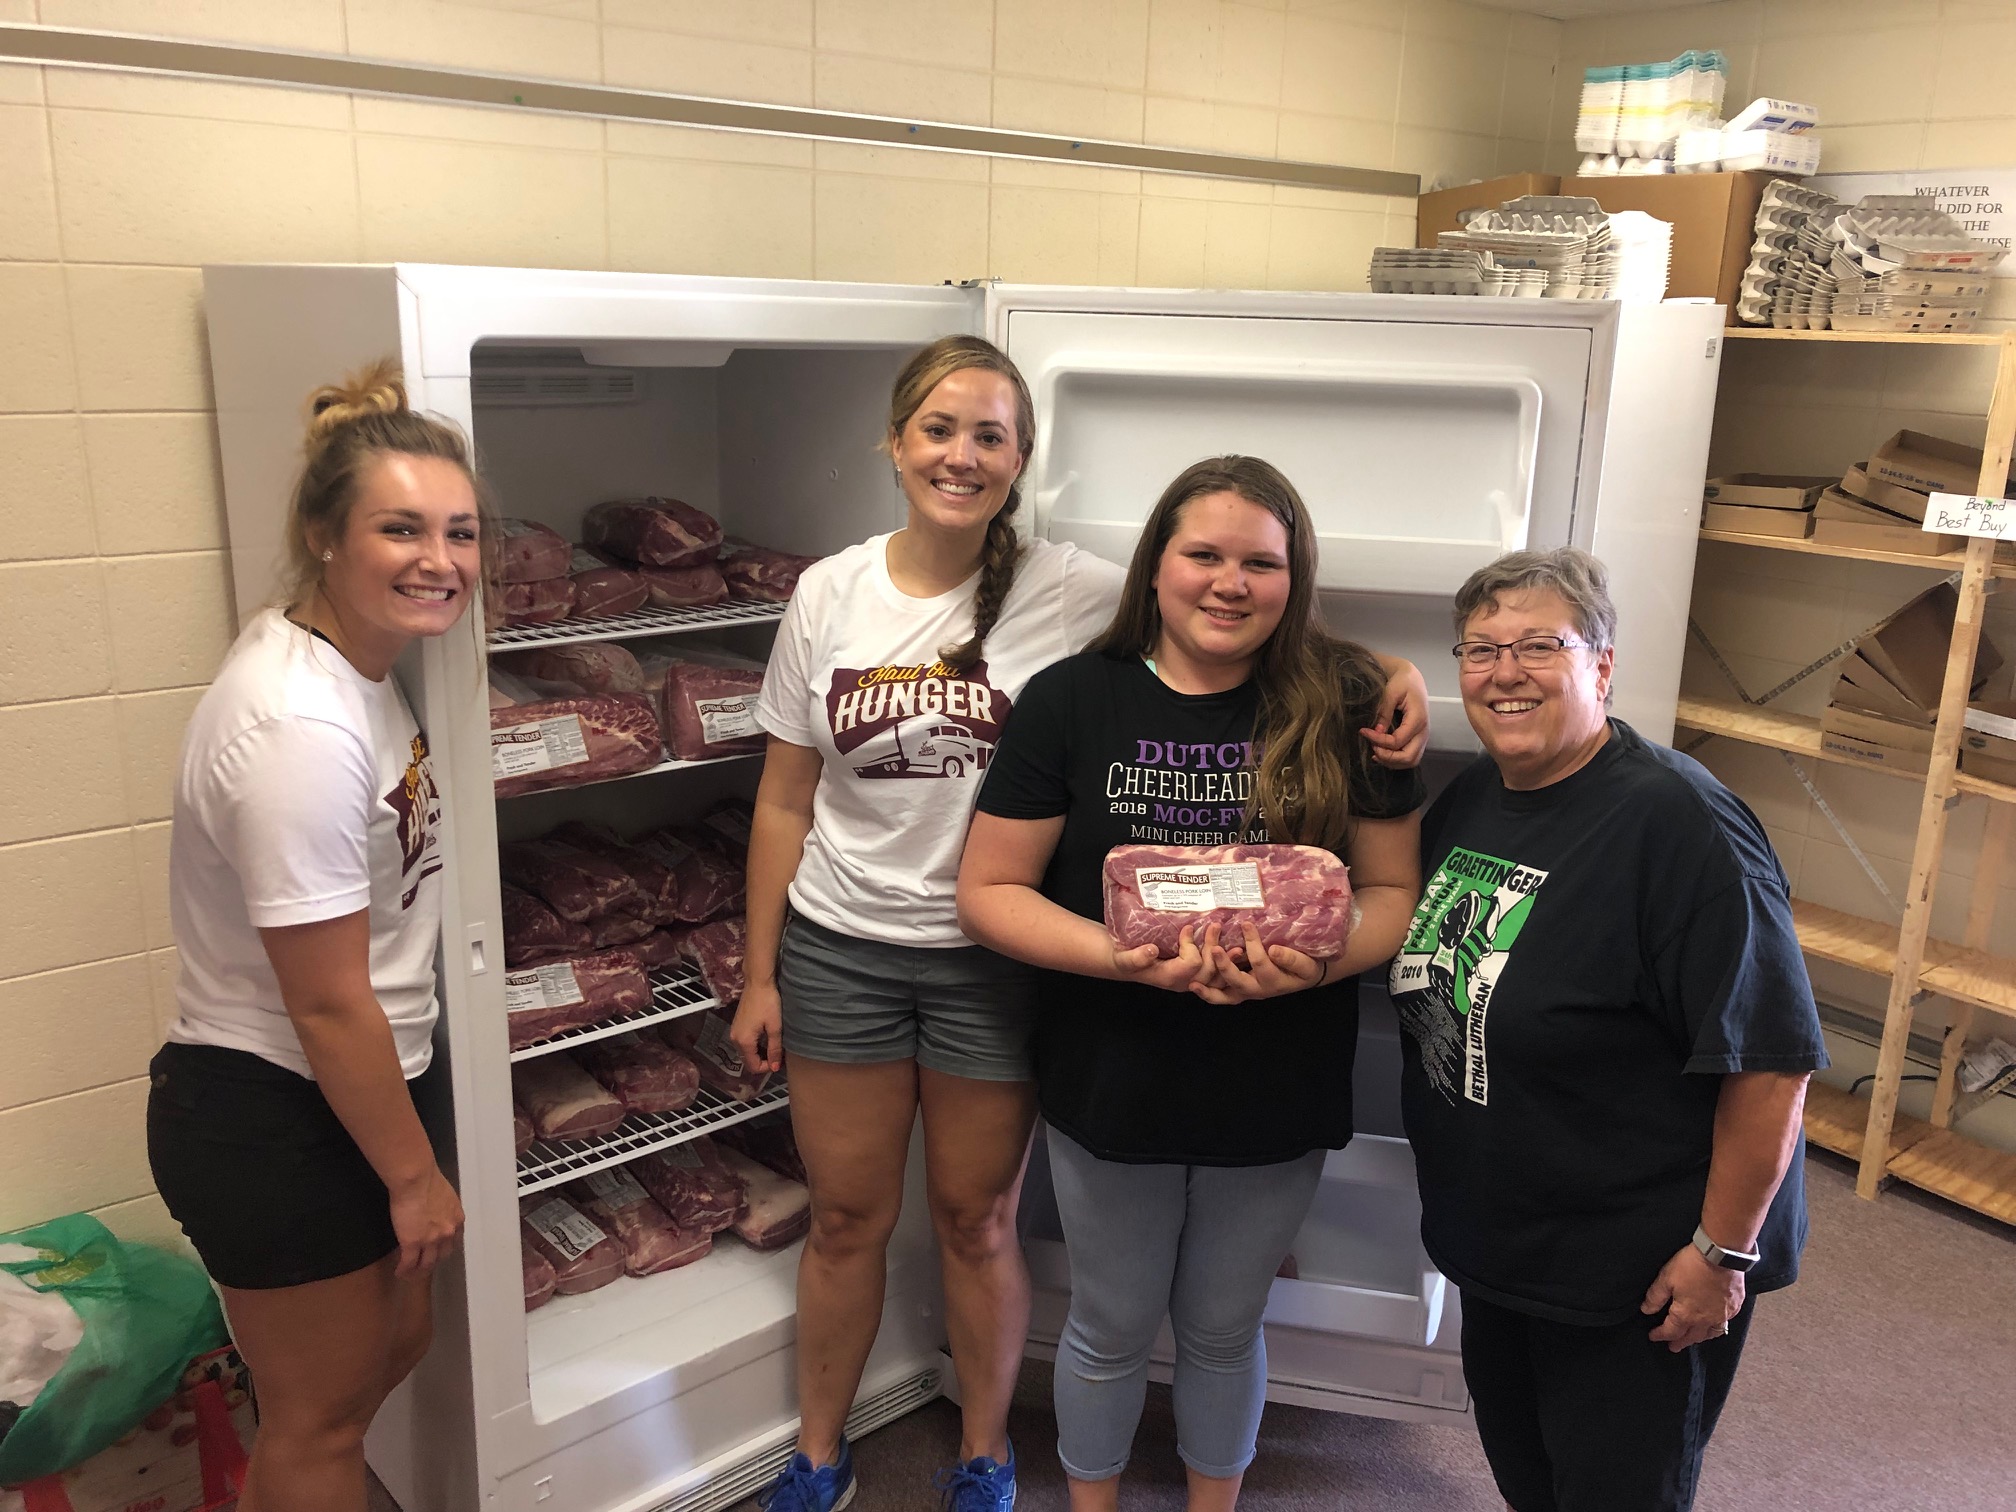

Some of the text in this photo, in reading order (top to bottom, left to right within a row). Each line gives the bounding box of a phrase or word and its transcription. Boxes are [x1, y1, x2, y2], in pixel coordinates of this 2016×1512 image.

[1914, 185, 1990, 198] WHATEVER
[1946, 203, 1972, 214] DID
[1975, 203, 2003, 214] FOR
[1963, 220, 1991, 231] THE
[1970, 237, 2012, 248] ESE
[1964, 497, 2007, 514] Beyond
[1935, 511, 2008, 537] Best Buy
[858, 663, 925, 688] Haul
[833, 677, 998, 736] HUNGER
[492, 731, 541, 745] PREME TENDER
[1135, 739, 1266, 769] DUTCH
[1109, 802, 1147, 815] 2018
[1130, 824, 1169, 843] MINI
[1173, 830, 1224, 845] CHEER
[1141, 873, 1210, 884] SUPREME TENDER
[1446, 851, 1544, 897] GRAETTINGER
[1418, 869, 1448, 913] DAY
[1433, 903, 1448, 923] MILE
[1445, 879, 1463, 904] WALK
[1410, 876, 1459, 949] FUN RUN
[1440, 949, 1453, 960] 5th
[1400, 965, 1422, 980] 2010
[1469, 981, 1493, 1101] BETHAL LUTHERAN
